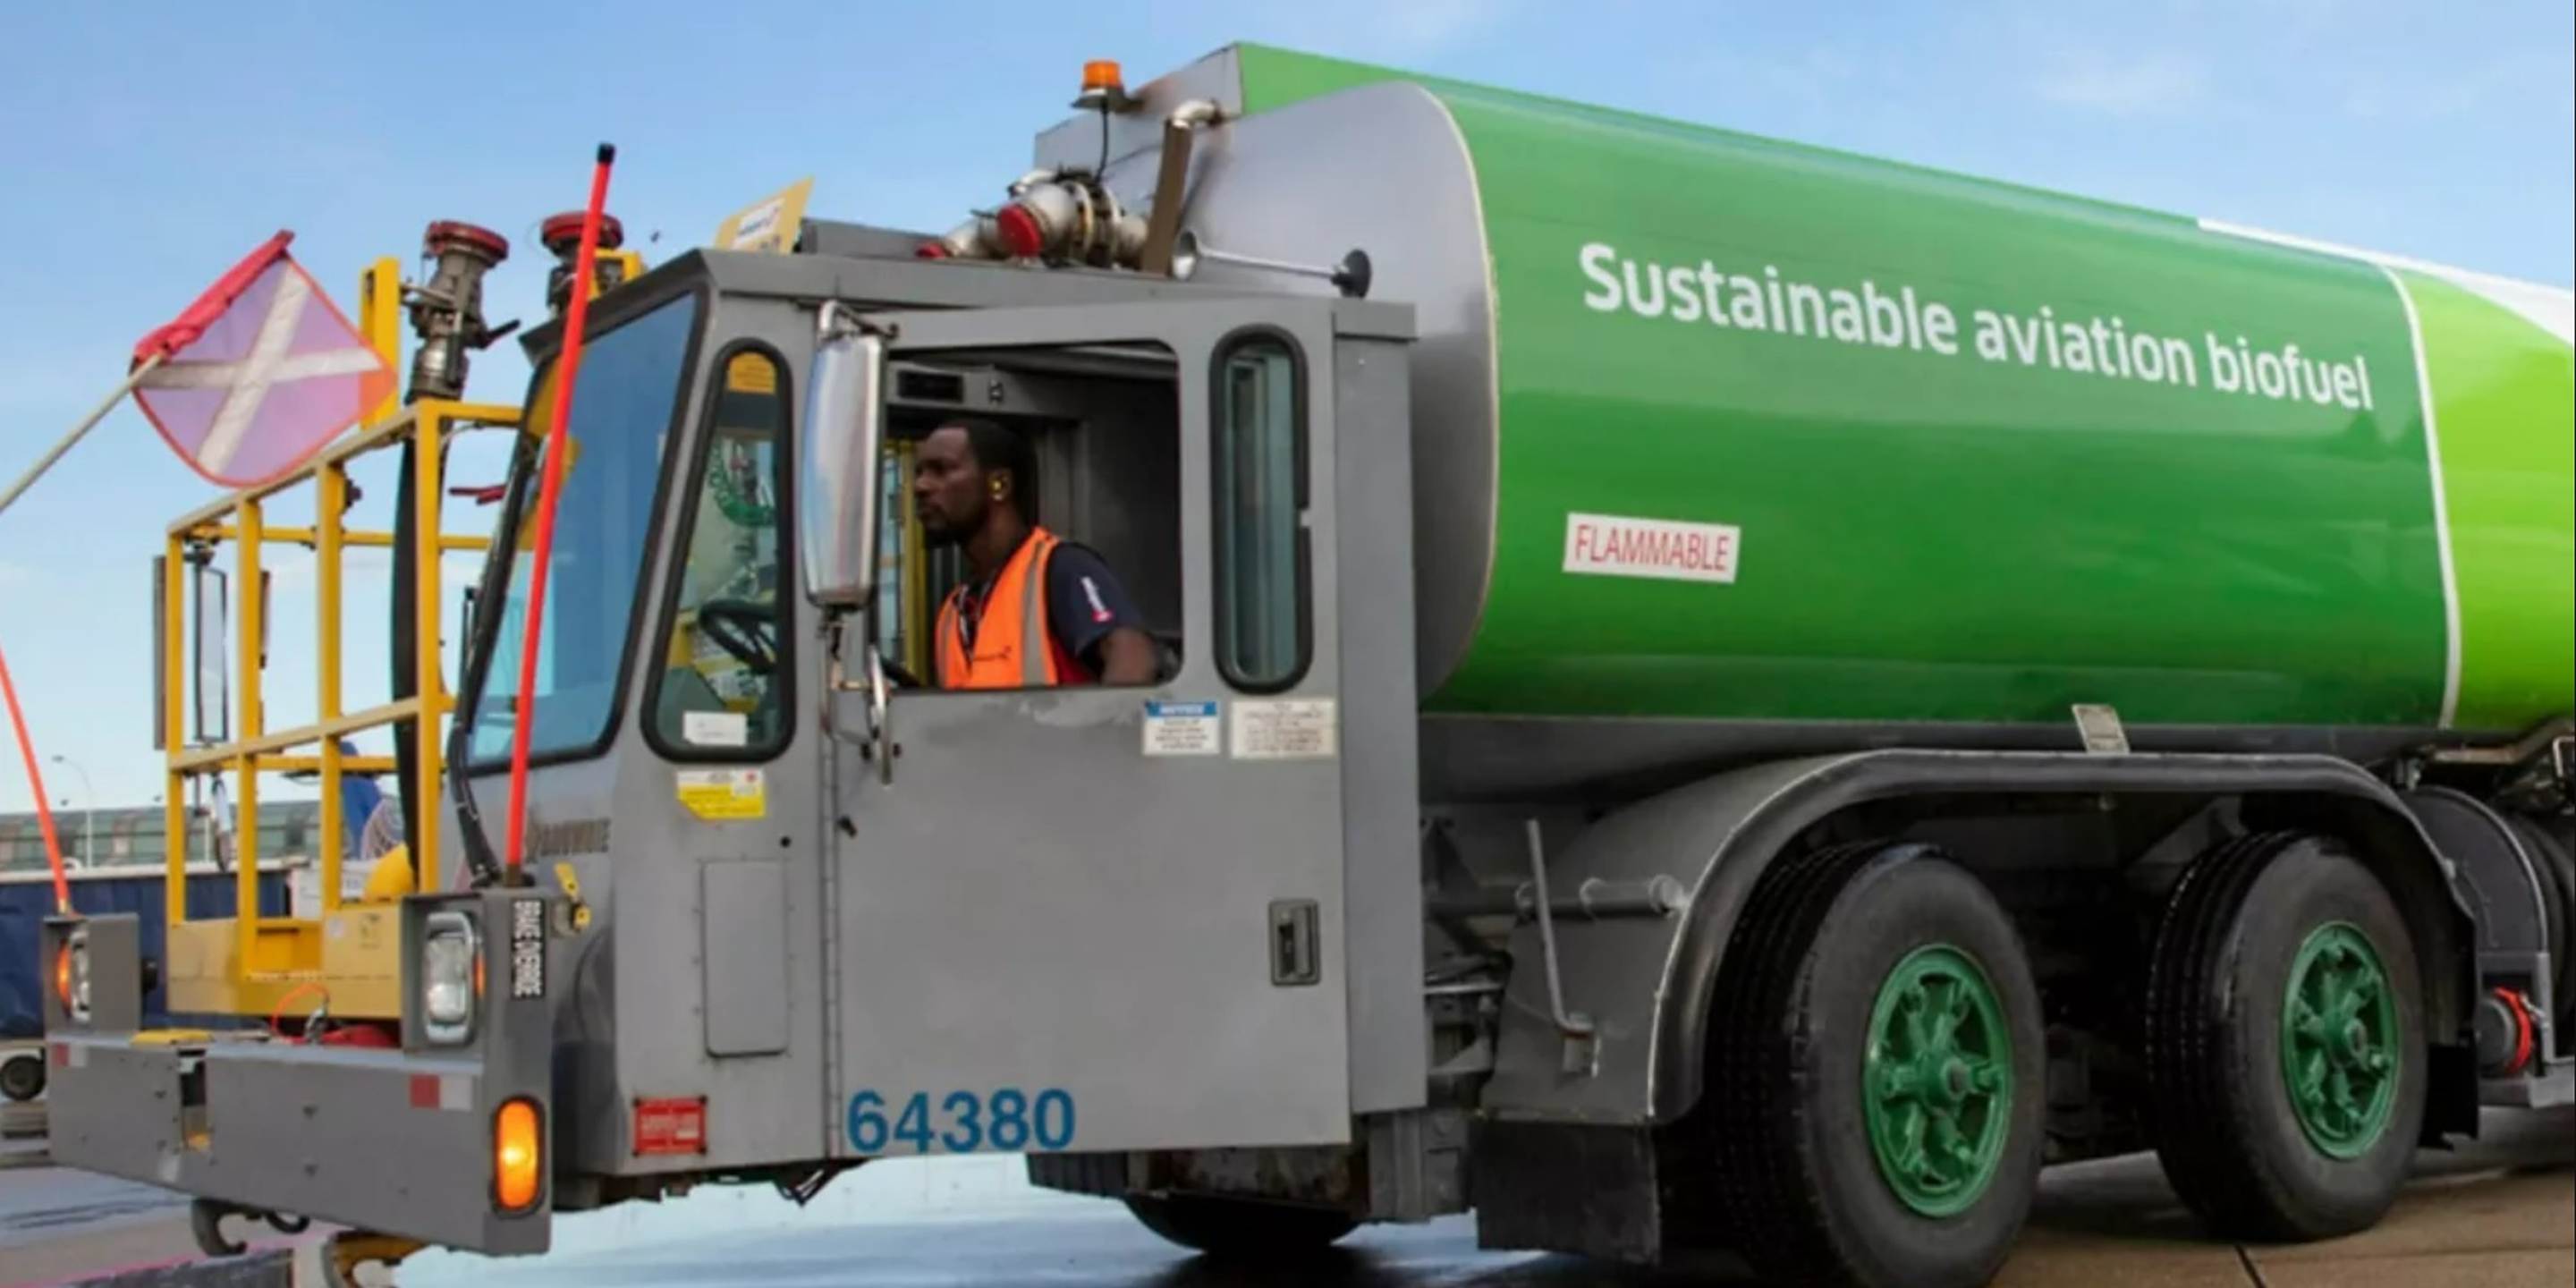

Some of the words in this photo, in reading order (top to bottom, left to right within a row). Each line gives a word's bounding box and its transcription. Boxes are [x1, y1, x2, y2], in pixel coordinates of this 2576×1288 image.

[1580, 242, 1959, 355] Sustainable
[1973, 306, 2197, 387] aviation
[2206, 331, 2374, 411] biofuel
[1575, 524, 1730, 571] FLAMMABLE
[514, 901, 541, 939] BRAKE
[514, 941, 541, 996] OVERRIDE
[848, 1088, 1076, 1153] 64380
